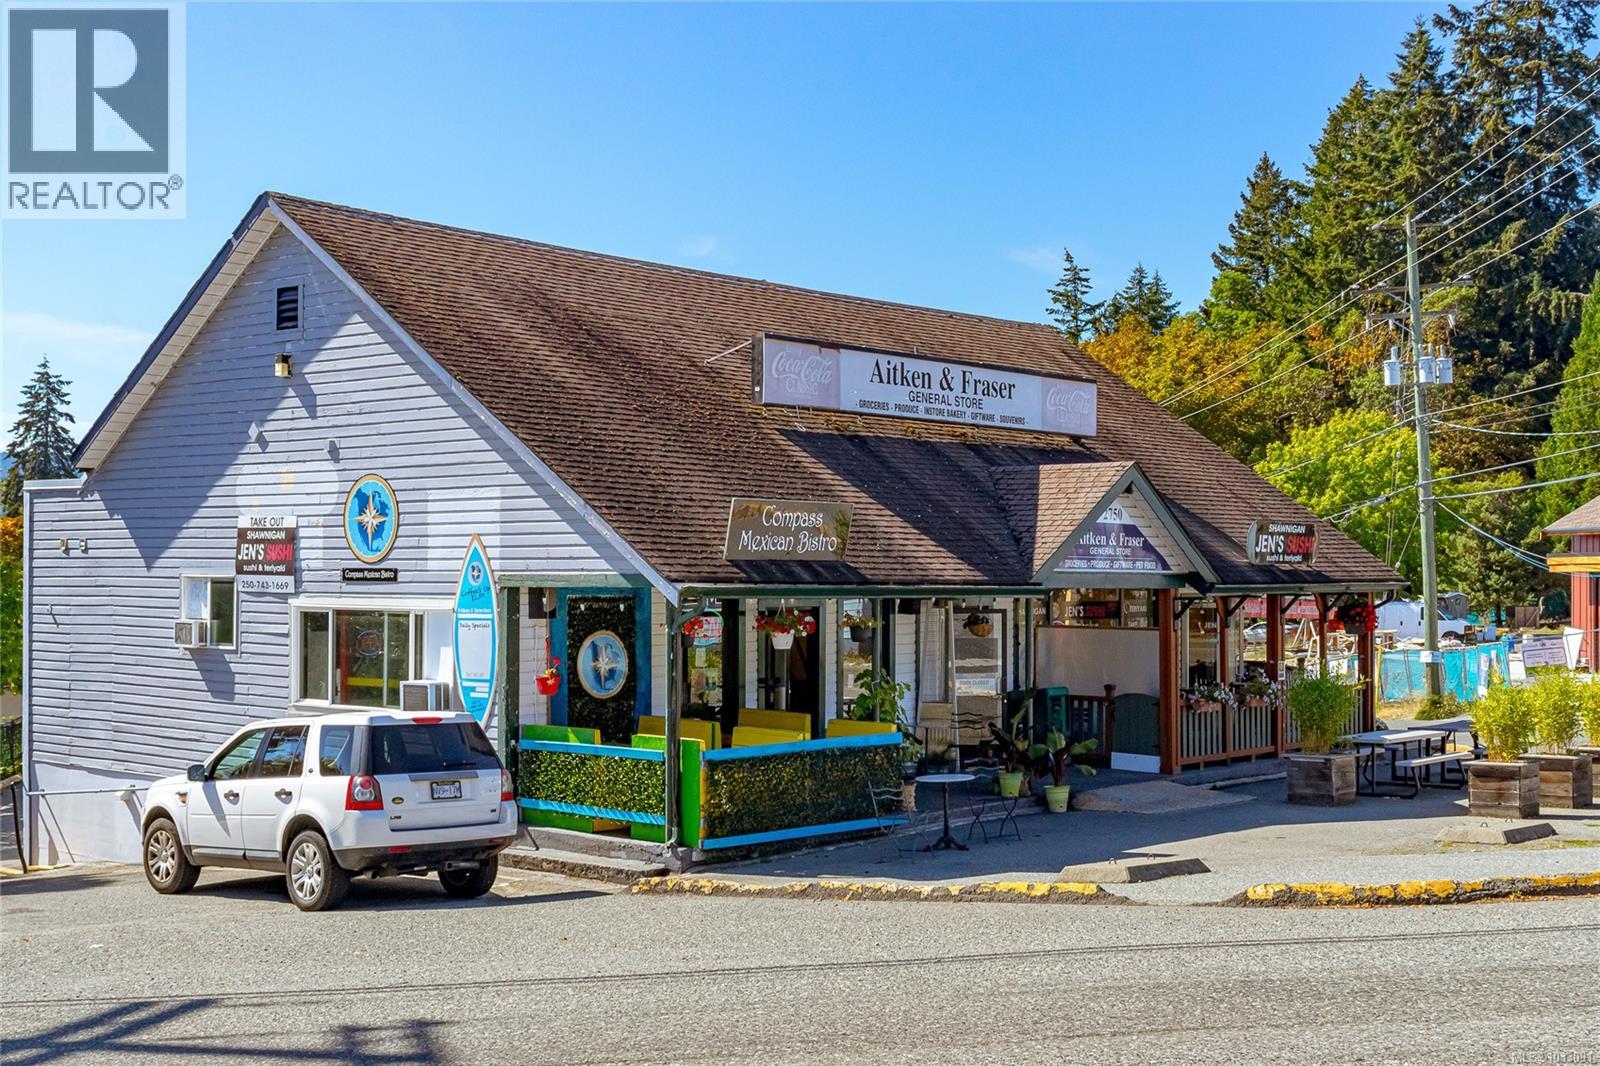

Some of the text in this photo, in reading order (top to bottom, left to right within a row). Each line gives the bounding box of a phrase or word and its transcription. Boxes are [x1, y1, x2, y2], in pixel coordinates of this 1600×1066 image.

[869, 358, 1015, 400] Aitken & Fraser
[908, 390, 984, 410] GENERAL STORE
[858, 400, 1026, 425] GROCERIES PRODUCE INSTORE BAKERY GIFTWARE SOUVENIRS
[250, 517, 285, 527] TAKE OUT
[762, 504, 824, 531] Compass
[246, 530, 286, 540] SHAWNIGAN
[1269, 523, 1306, 534] SHAWNIGAN
[738, 530, 837, 554] Mexican Bistro
[1109, 532, 1117, 546] &
[1120, 532, 1145, 547] Fraser
[1255, 534, 1285, 553] JEN'S
[237, 543, 293, 561] JEN'S SUSHI
[1089, 547, 1132, 556] GENERAL STORE
[264, 564, 286, 573] teriyaki
[1064, 559, 1088, 568] GROCERIES
[1090, 560, 1111, 569] PRODUCE
[242, 580, 289, 590] 250-743-1669
[1064, 605, 1084, 617] JEN'S
